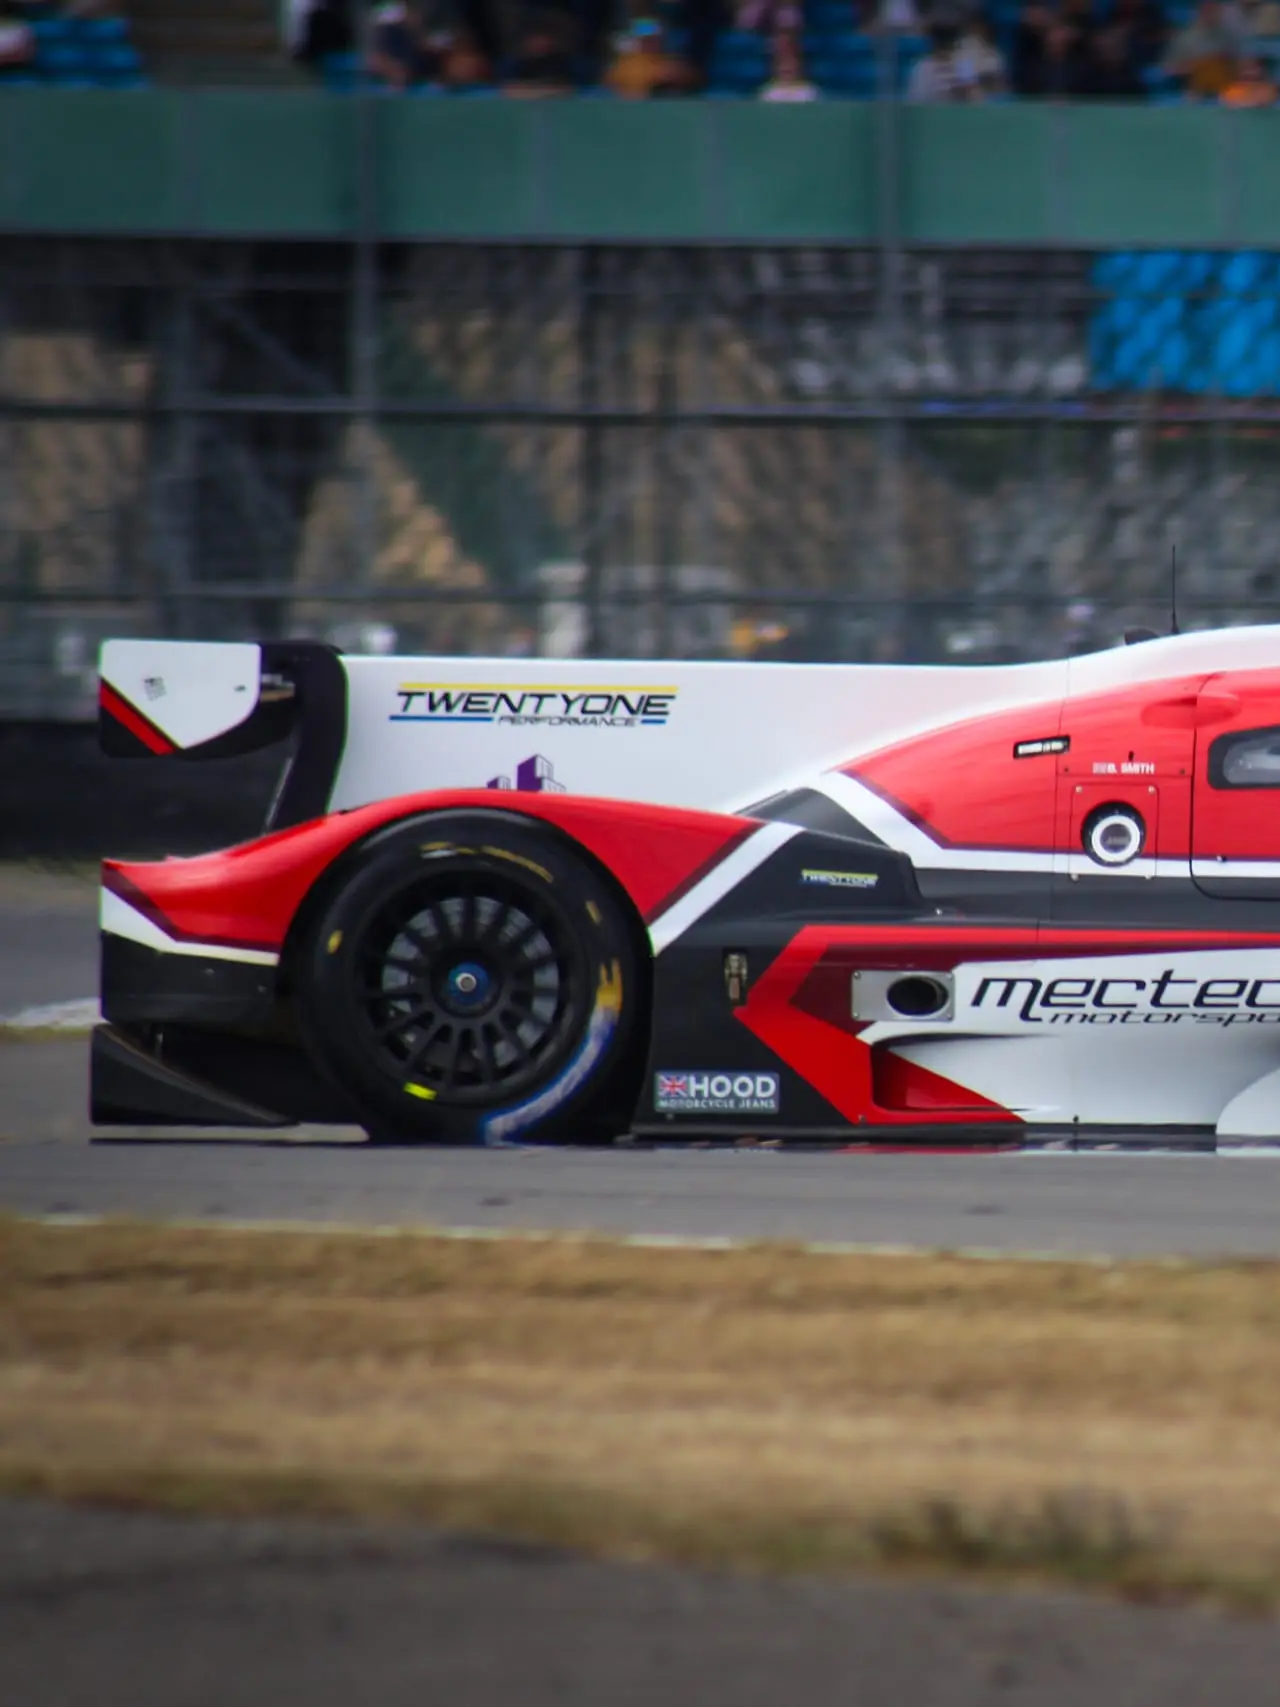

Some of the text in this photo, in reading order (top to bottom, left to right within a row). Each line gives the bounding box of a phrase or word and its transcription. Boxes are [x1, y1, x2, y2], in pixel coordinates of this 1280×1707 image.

[397, 690, 676, 716] TWENTYONE
[497, 715, 640, 729] PERFORMANCE
[688, 1075, 776, 1098] HOOD
[659, 1098, 776, 1109] MOTORCYCLE JEANS
